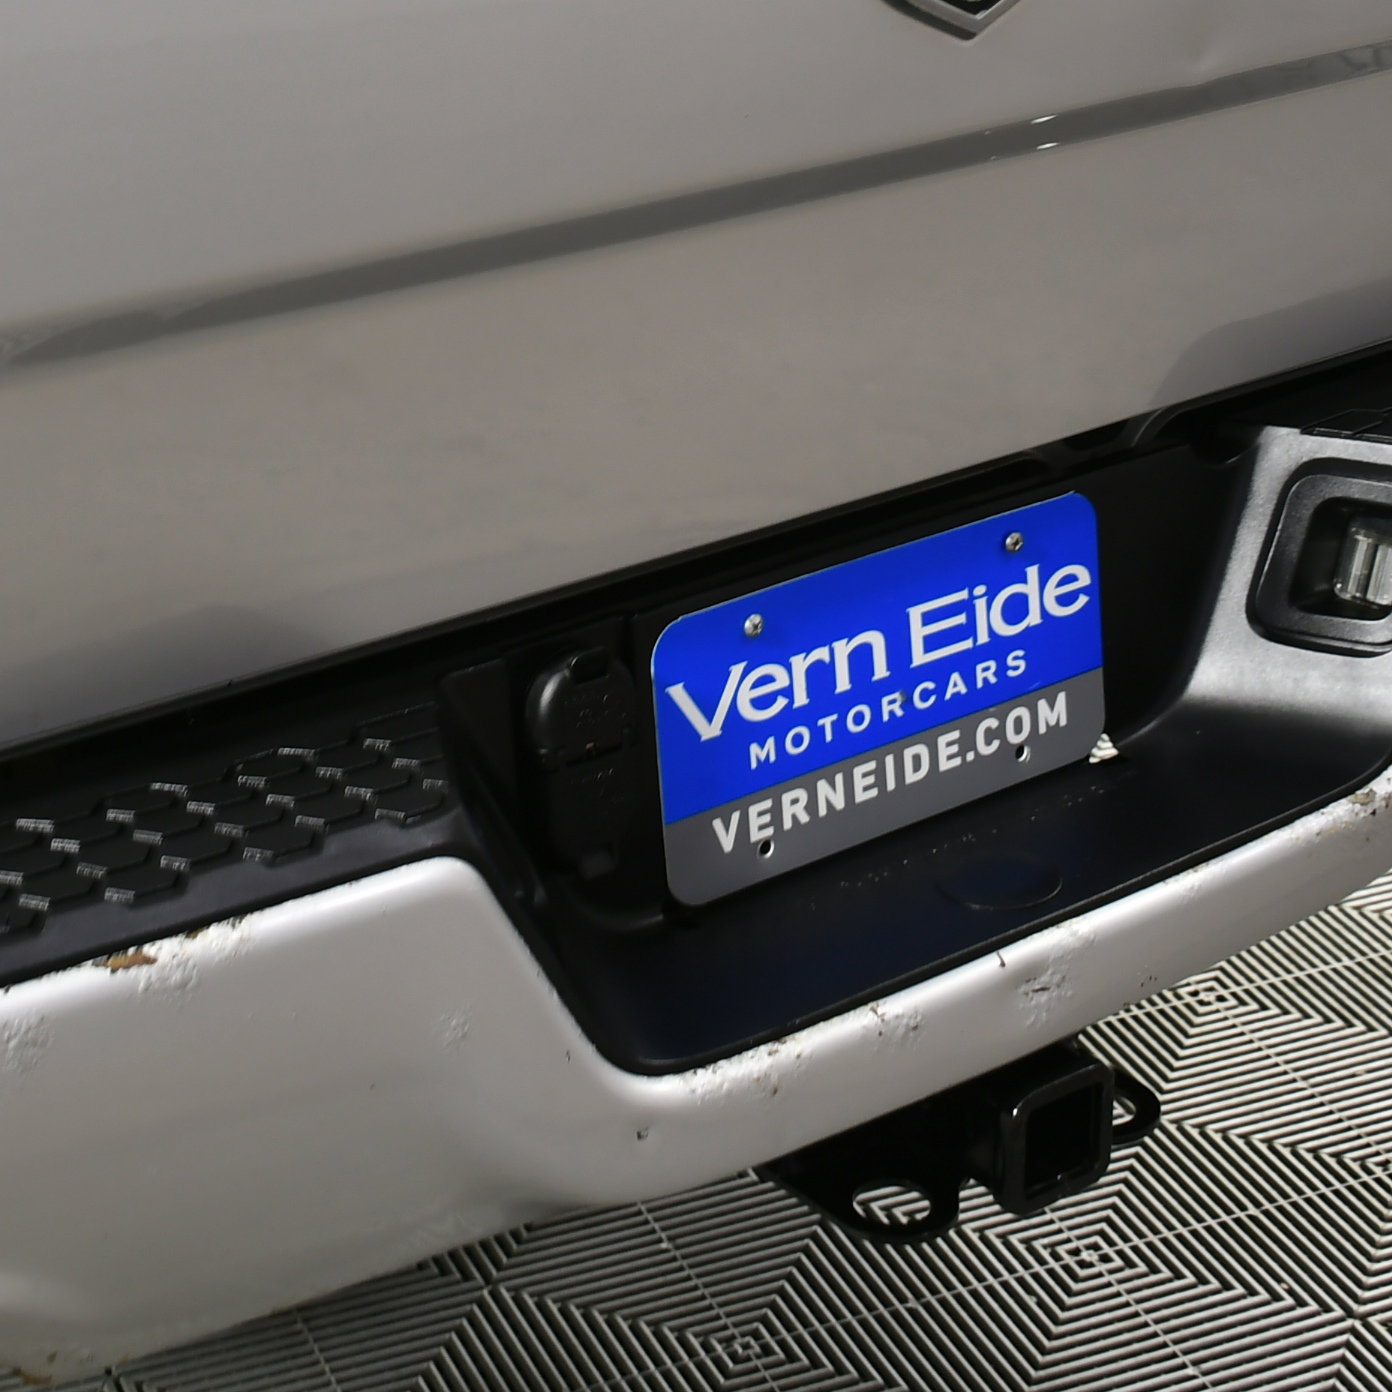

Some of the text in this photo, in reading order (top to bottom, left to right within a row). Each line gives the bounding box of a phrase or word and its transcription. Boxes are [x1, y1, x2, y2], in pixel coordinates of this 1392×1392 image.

[665, 563, 1092, 742] Vern Eide
[749, 650, 1027, 769] MOTORCARS
[712, 692, 1068, 853] VERNEIDE.COM
